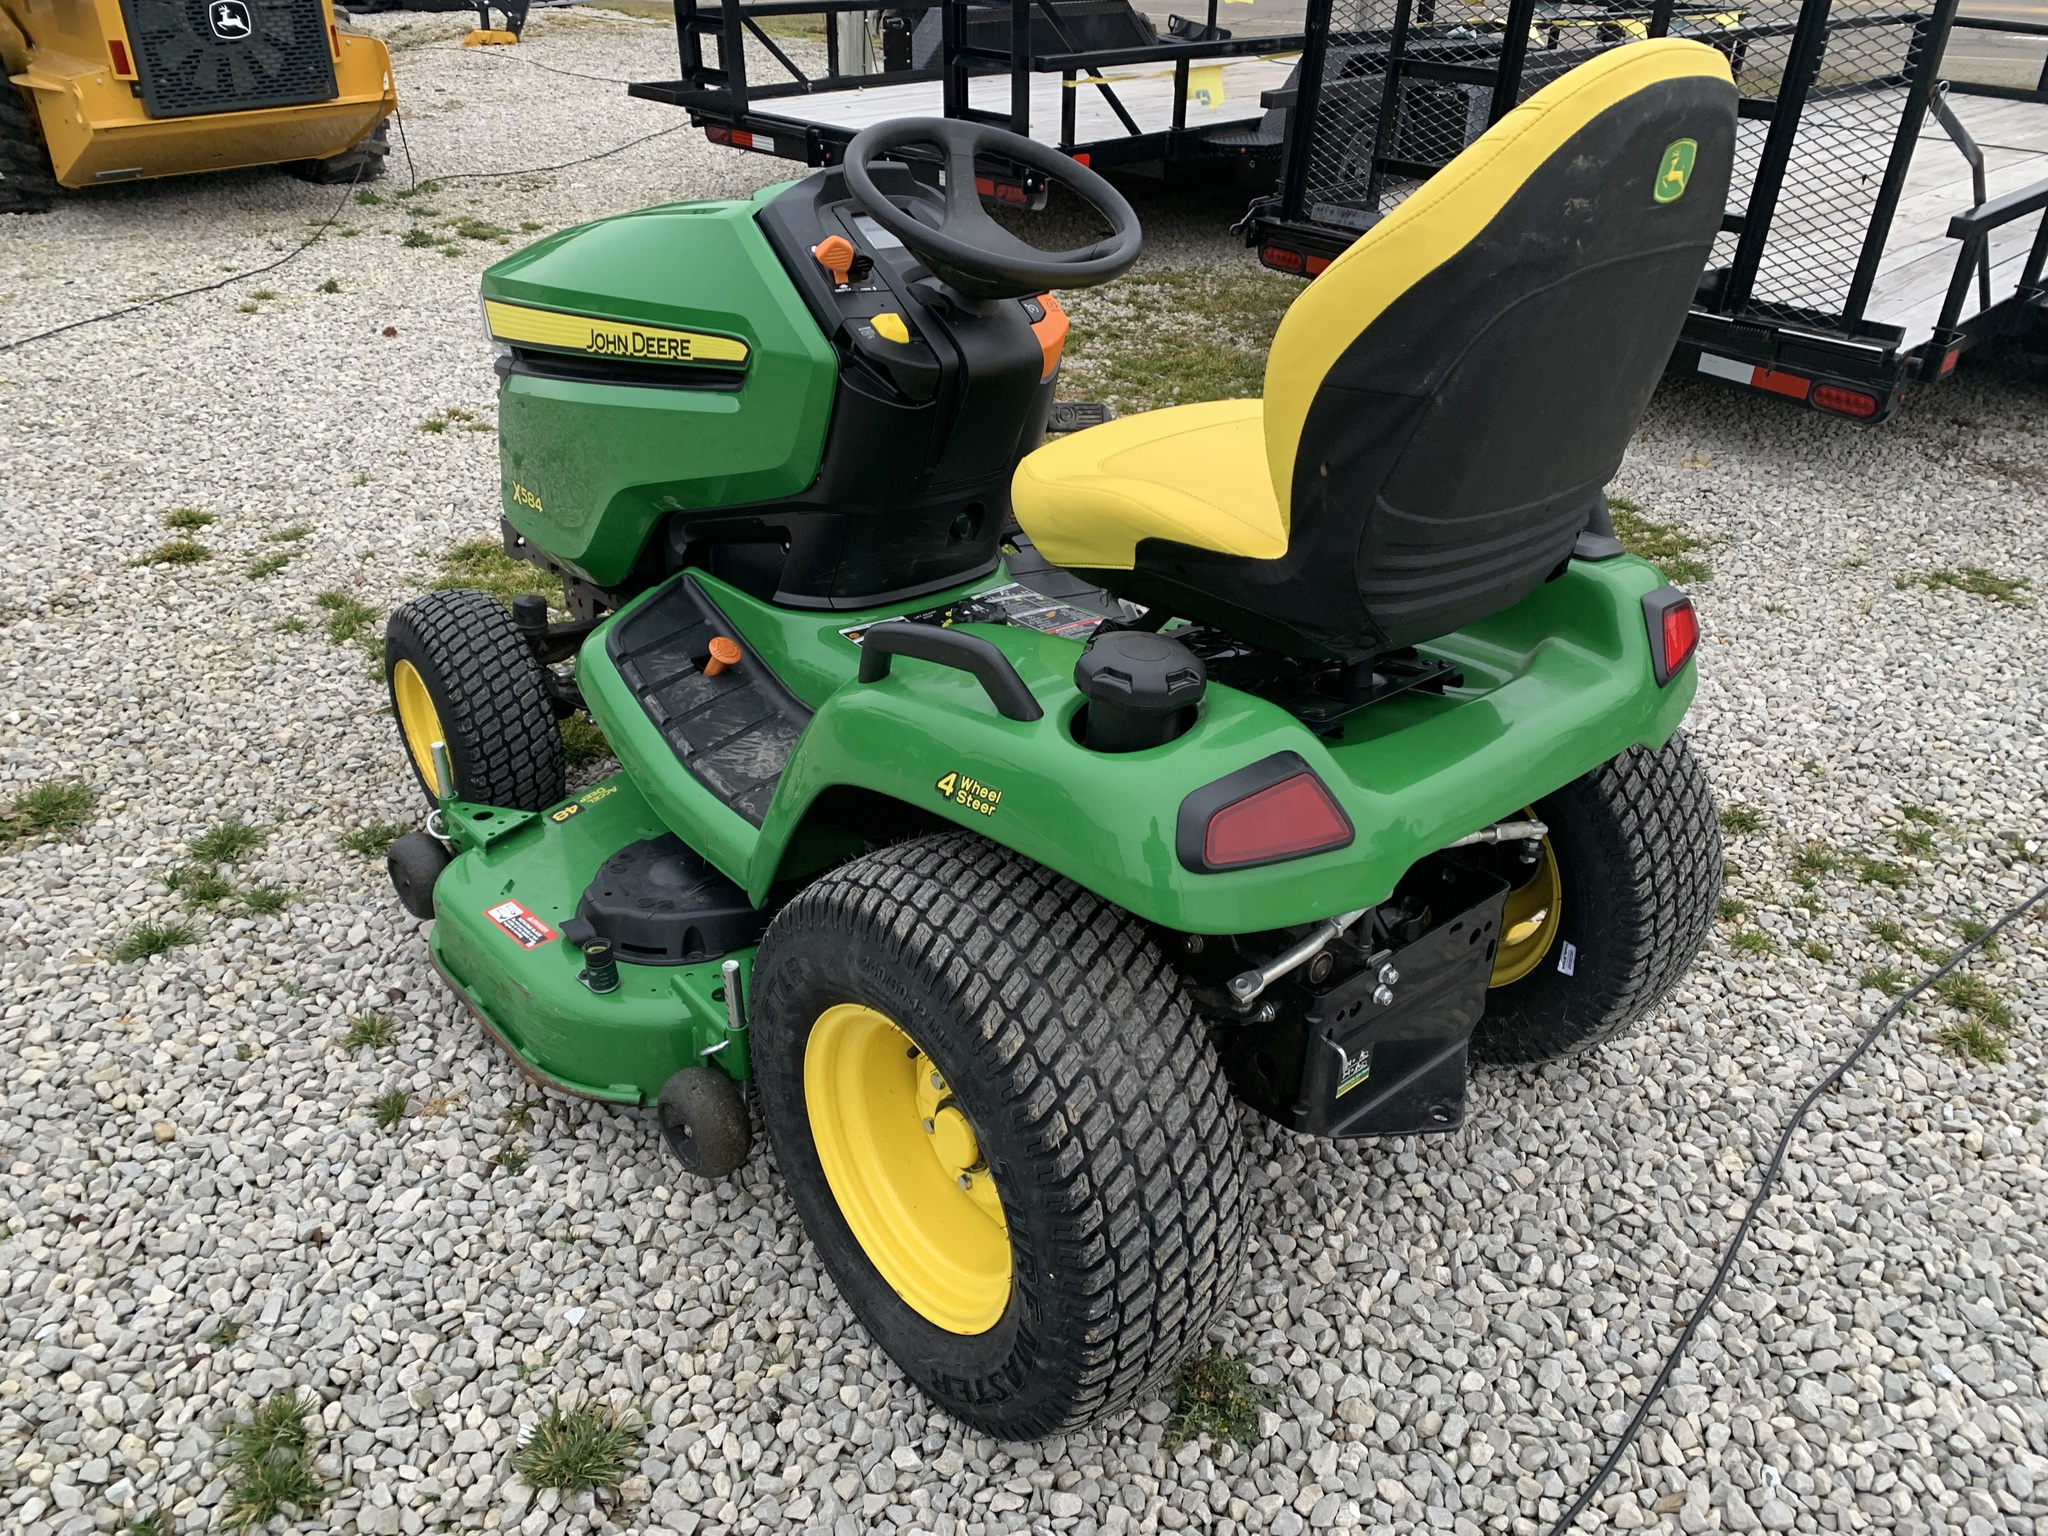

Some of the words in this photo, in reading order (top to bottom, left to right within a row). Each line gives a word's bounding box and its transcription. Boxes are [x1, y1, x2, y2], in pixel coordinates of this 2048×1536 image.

[586, 328, 629, 354] JOHN
[631, 331, 692, 358] DEERE
[512, 480, 543, 513] X584
[579, 787, 606, 803] DEEP
[586, 785, 618, 804] ACCEL
[937, 772, 957, 797] 4
[961, 775, 1002, 804] Wheel
[956, 789, 996, 816] Steer
[552, 804, 578, 821] 48
[997, 1159, 1042, 1325] TURF
[931, 1317, 1040, 1406] MASTER
